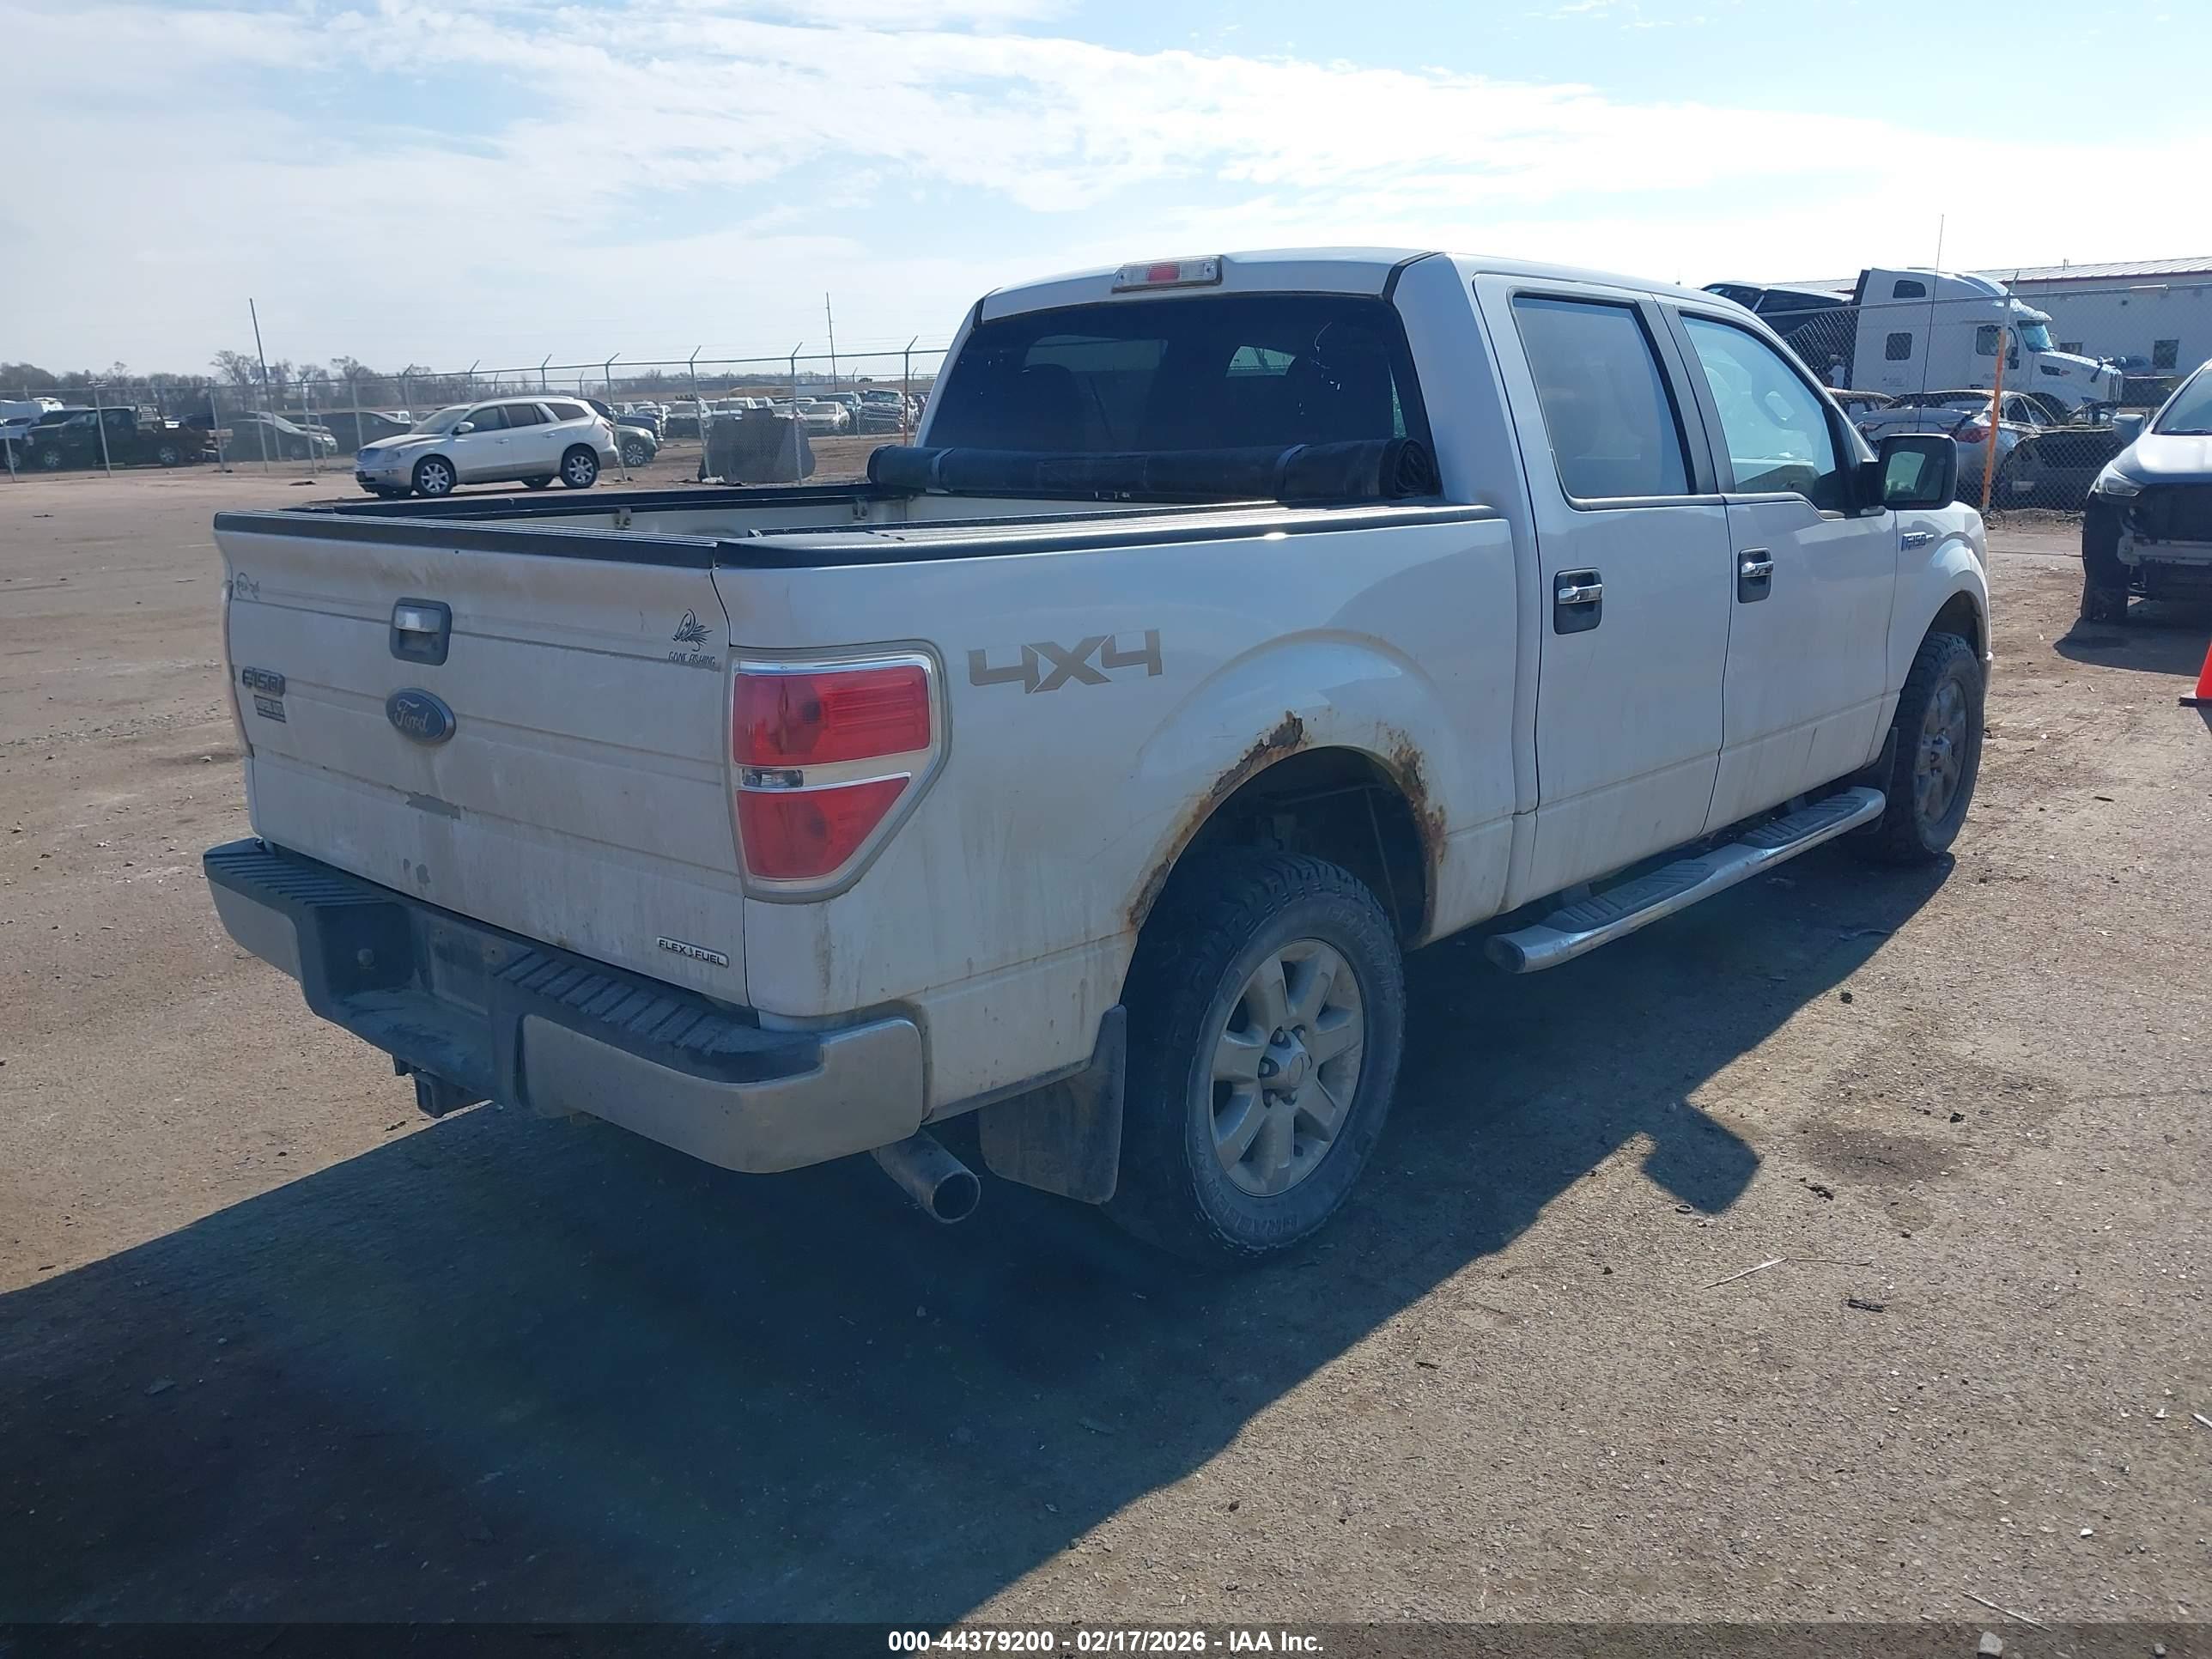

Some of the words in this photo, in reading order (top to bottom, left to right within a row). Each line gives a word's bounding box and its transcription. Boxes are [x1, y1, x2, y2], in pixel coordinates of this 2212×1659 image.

[394, 698, 430, 733] Ford
[659, 939, 687, 956] FLEX
[694, 949, 725, 966] FUEL
